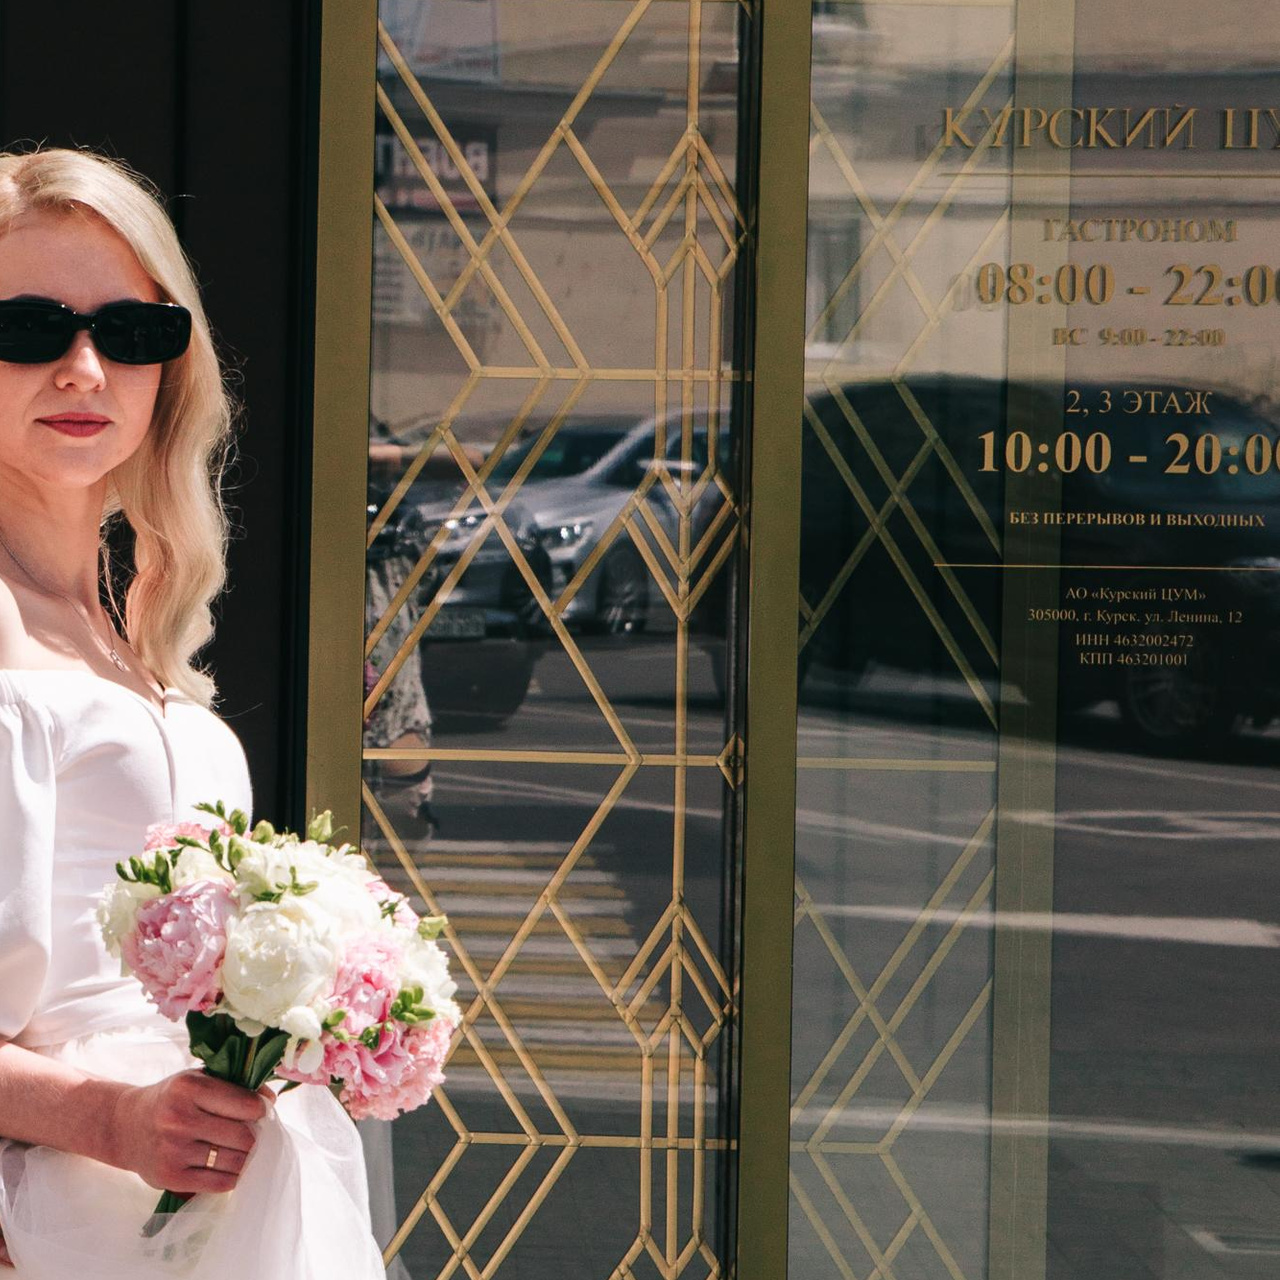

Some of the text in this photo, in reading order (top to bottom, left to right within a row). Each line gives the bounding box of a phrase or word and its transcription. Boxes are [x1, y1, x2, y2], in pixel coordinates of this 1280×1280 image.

[943, 103, 1200, 148] КУРСКИЙ
[1044, 219, 1240, 242] ГАСТРОНОМ
[978, 263, 1115, 305] 08:00
[1163, 264, 1280, 306] 22:0
[1052, 327, 1088, 346] ВС
[1066, 390, 1213, 417] 2, 3 ЭТАЖ
[977, 431, 1112, 473] 10:00
[1164, 433, 1280, 475] 20:0
[1009, 511, 1266, 528] БЕЗ ПЕРЕРЫВОВ И ВЫХОДНЫХ
[1066, 587, 1207, 603] АО «Курский ЦУМ»
[1228, 611, 1243, 623] 12
[1076, 634, 1110, 646] ИНН
[1080, 653, 1113, 666] КПП
